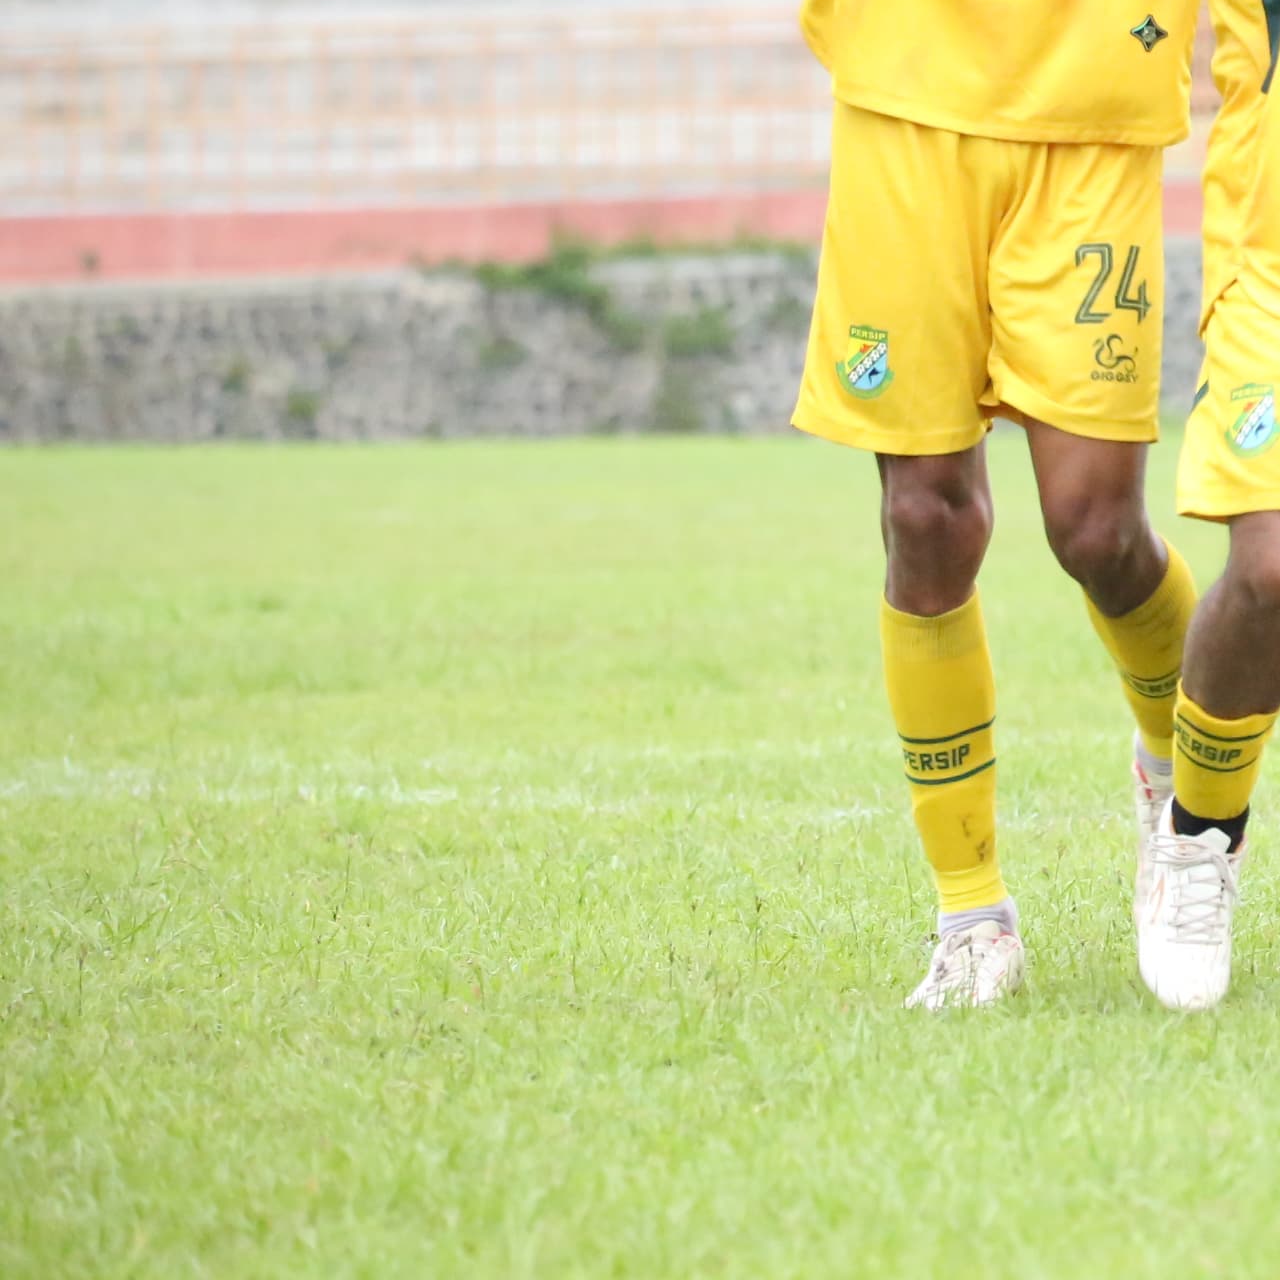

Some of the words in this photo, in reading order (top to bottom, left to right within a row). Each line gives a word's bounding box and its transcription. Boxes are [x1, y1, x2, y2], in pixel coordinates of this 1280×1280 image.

[1074, 243, 1151, 326] 24
[850, 326, 888, 340] PERSIP
[1091, 369, 1140, 384] GIGGSY
